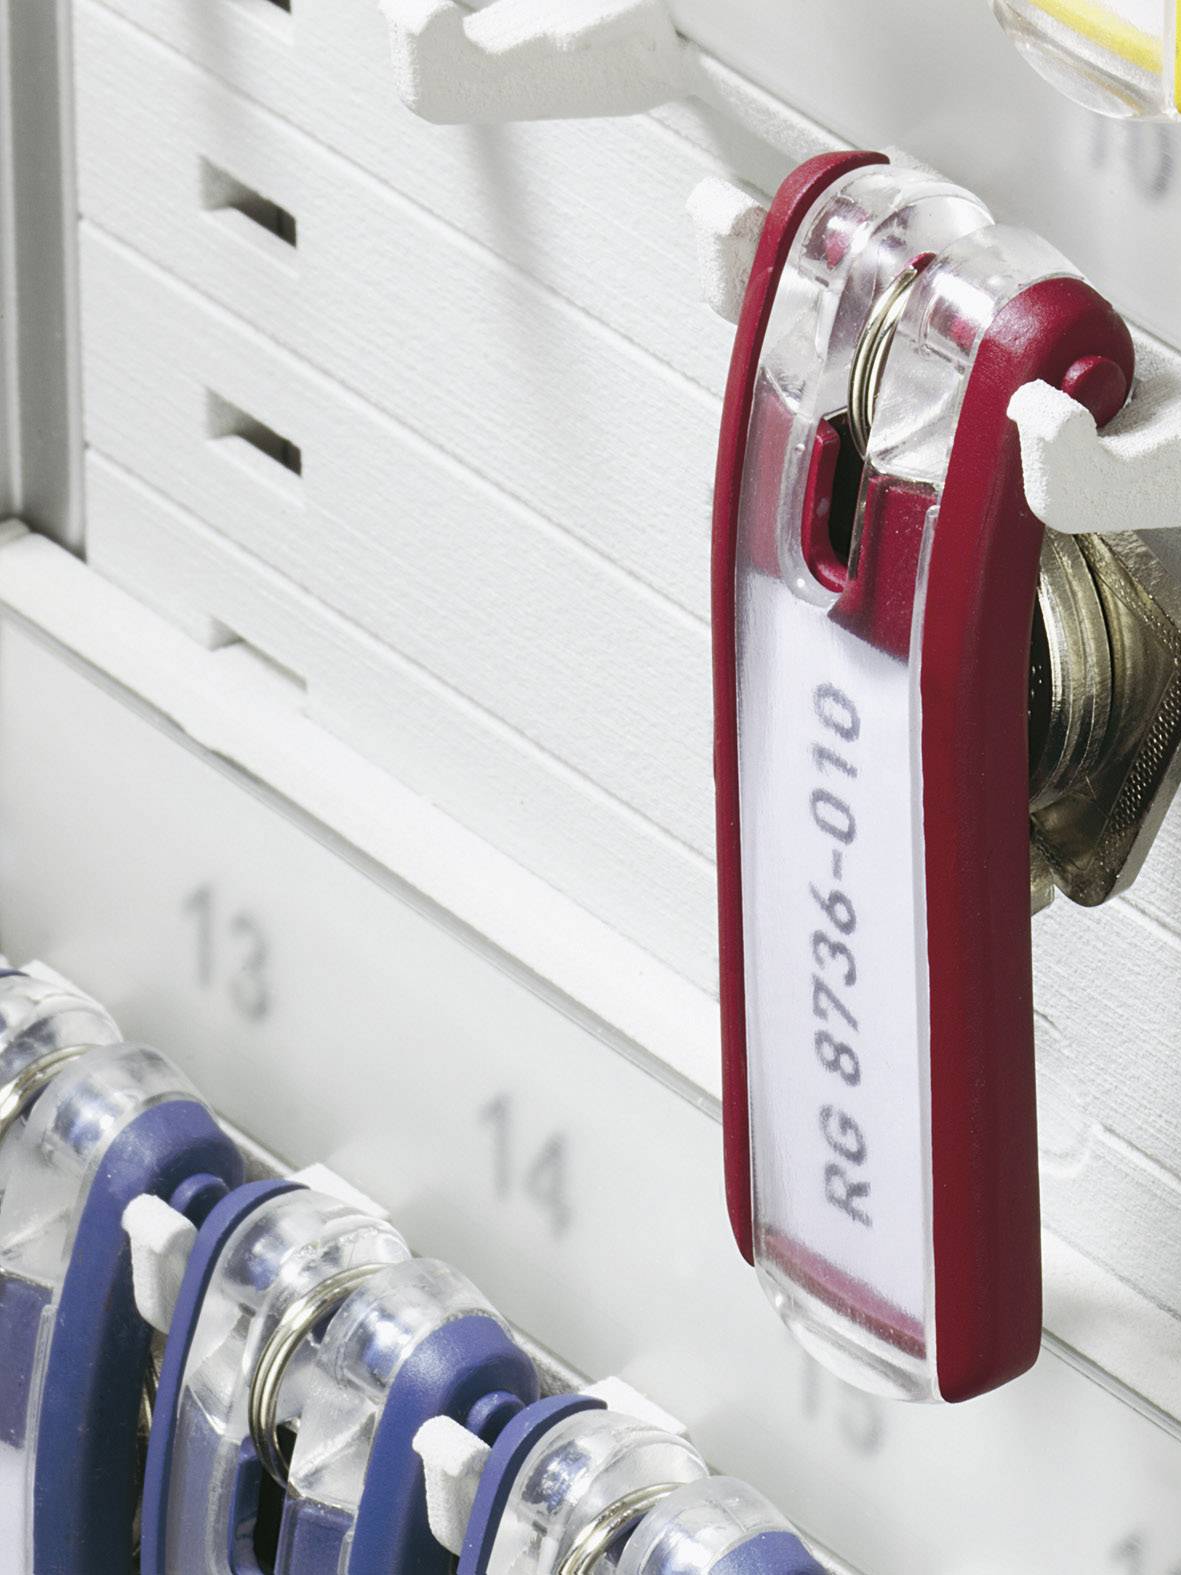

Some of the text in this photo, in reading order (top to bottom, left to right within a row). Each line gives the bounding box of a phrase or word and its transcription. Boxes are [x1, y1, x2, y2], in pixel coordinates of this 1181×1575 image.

[181, 884, 271, 1025] 13
[810, 682, 872, 1227] RG 8736-010
[478, 1093, 575, 1240] 14
